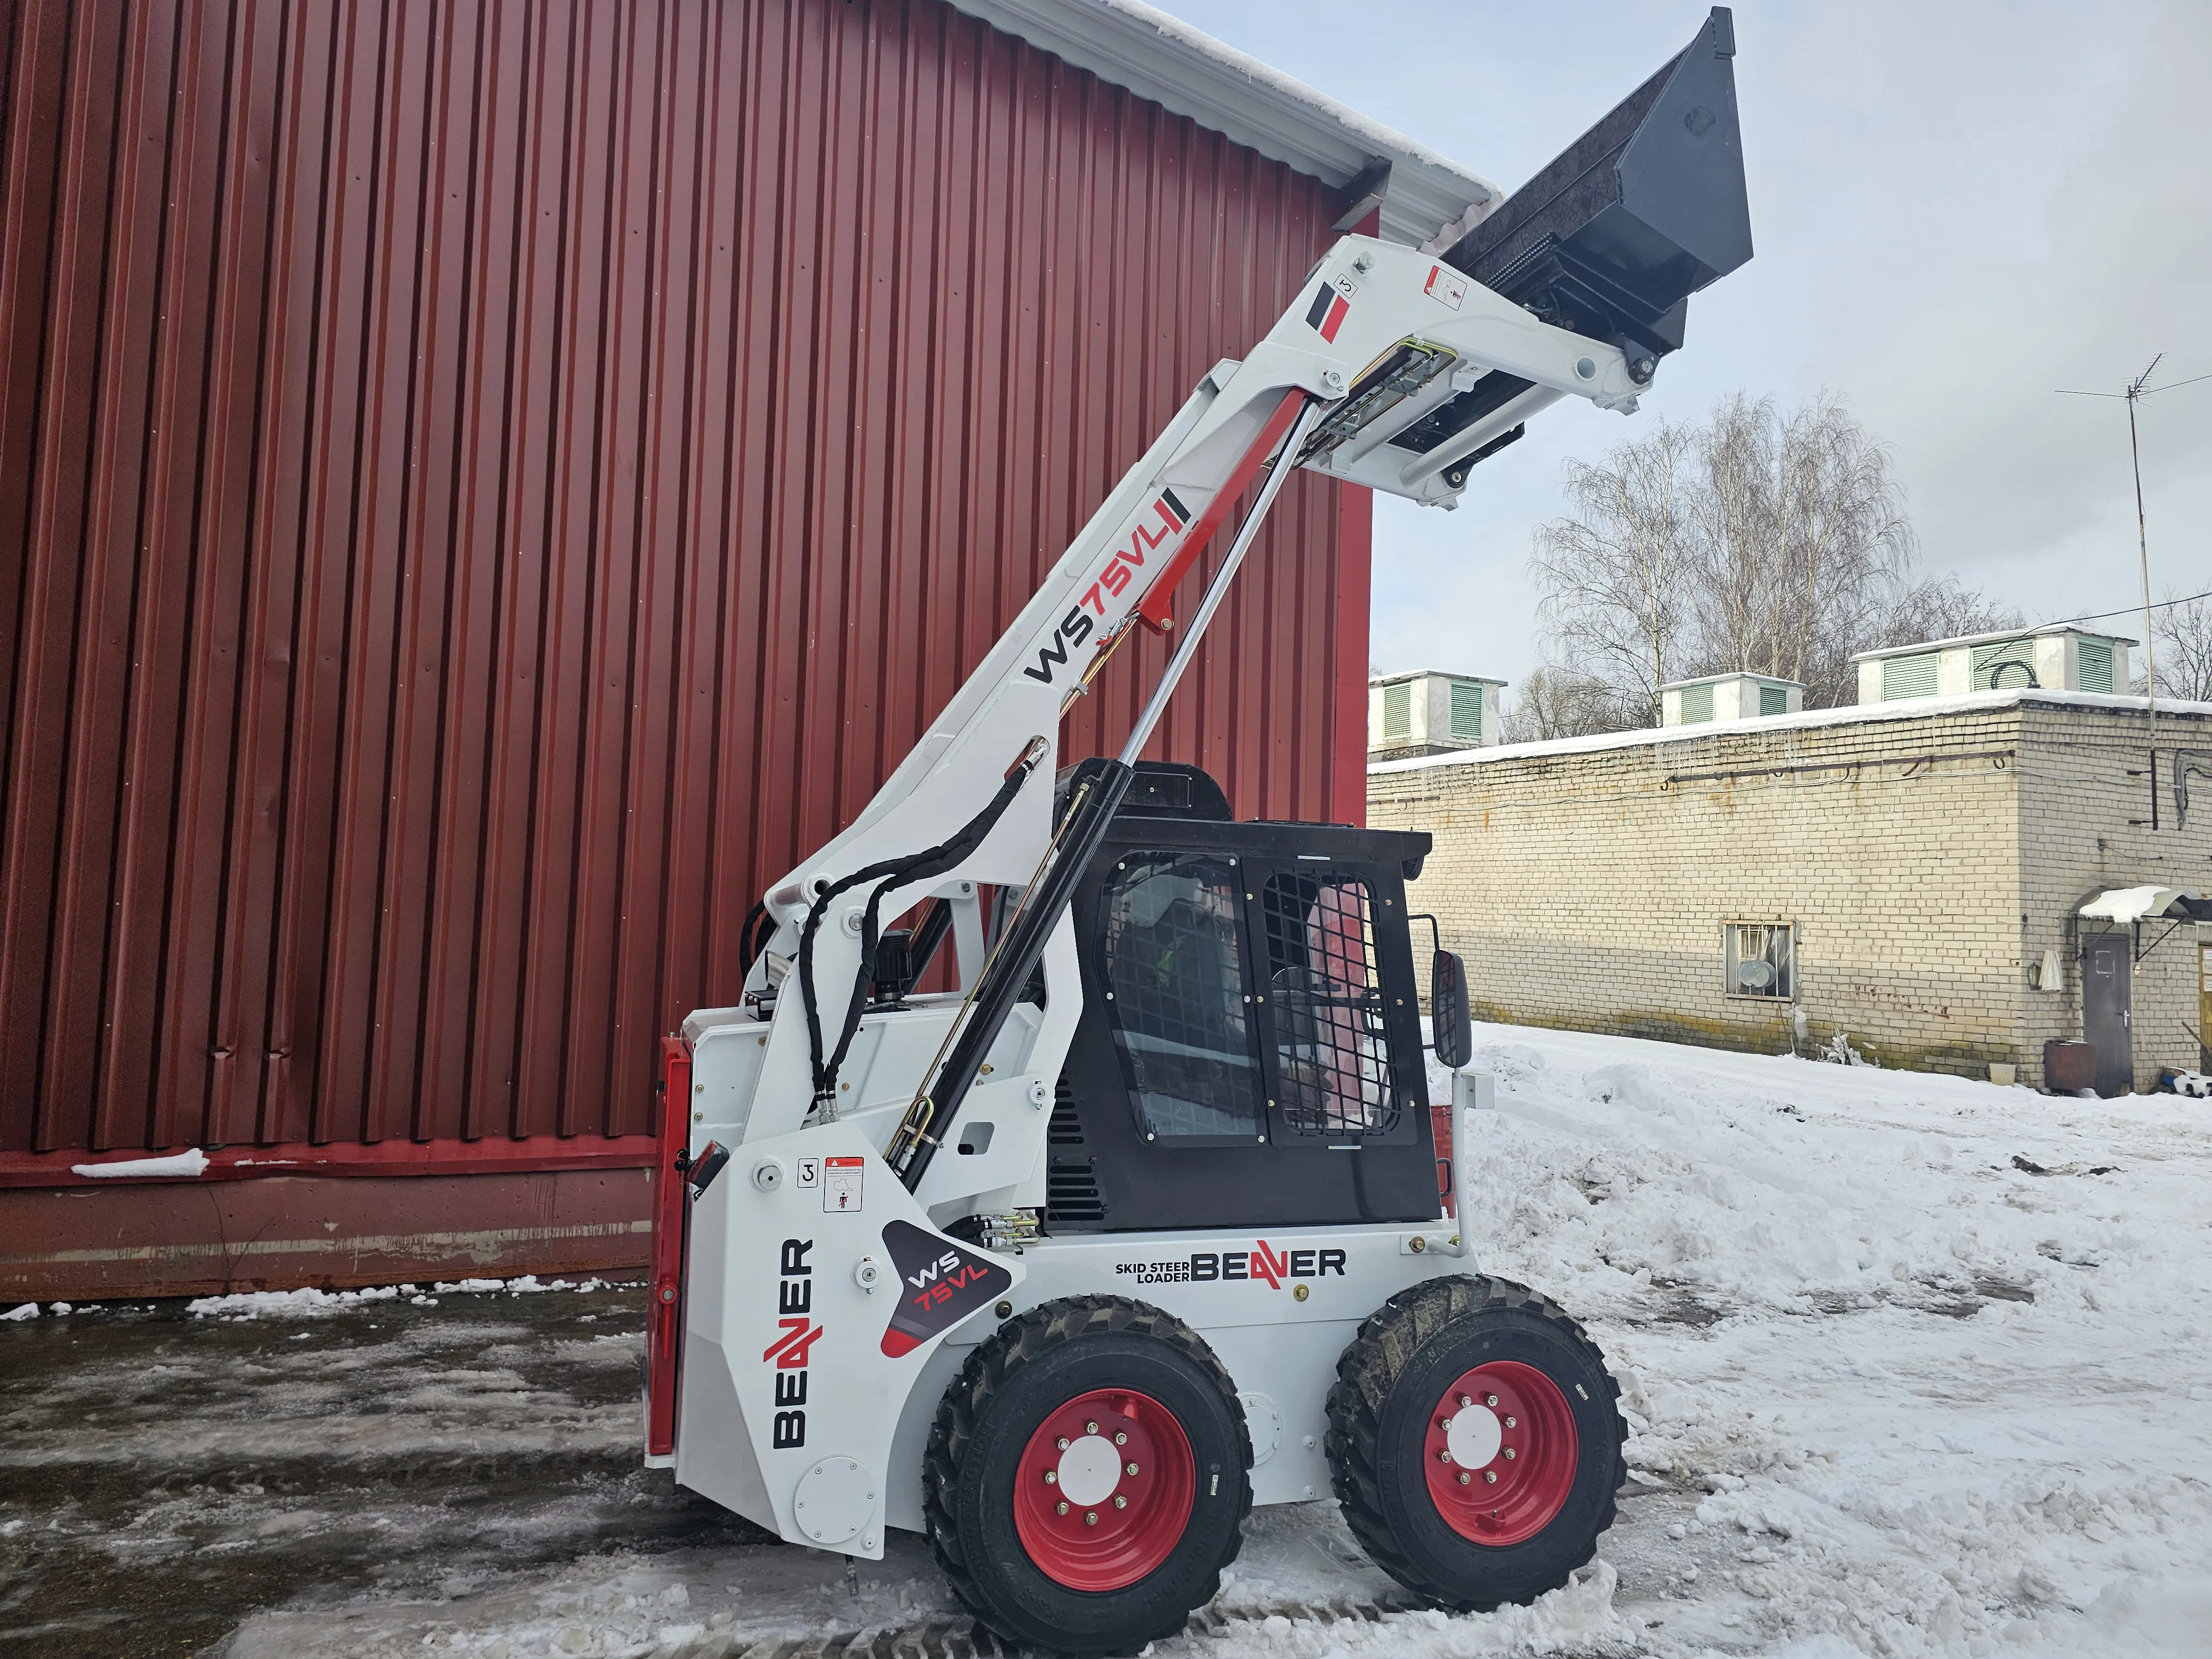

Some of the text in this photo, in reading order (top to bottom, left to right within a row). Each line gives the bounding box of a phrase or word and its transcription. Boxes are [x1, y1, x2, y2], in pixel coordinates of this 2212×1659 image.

[907, 1250, 960, 1288] WS
[1115, 1261, 1190, 1274] SKID STEER
[1137, 1272, 1190, 1284] LOADER
[1191, 1240, 1346, 1290] BEAVER
[914, 1264, 988, 1311] 75VL
[764, 1239, 823, 1449] BEAVER
